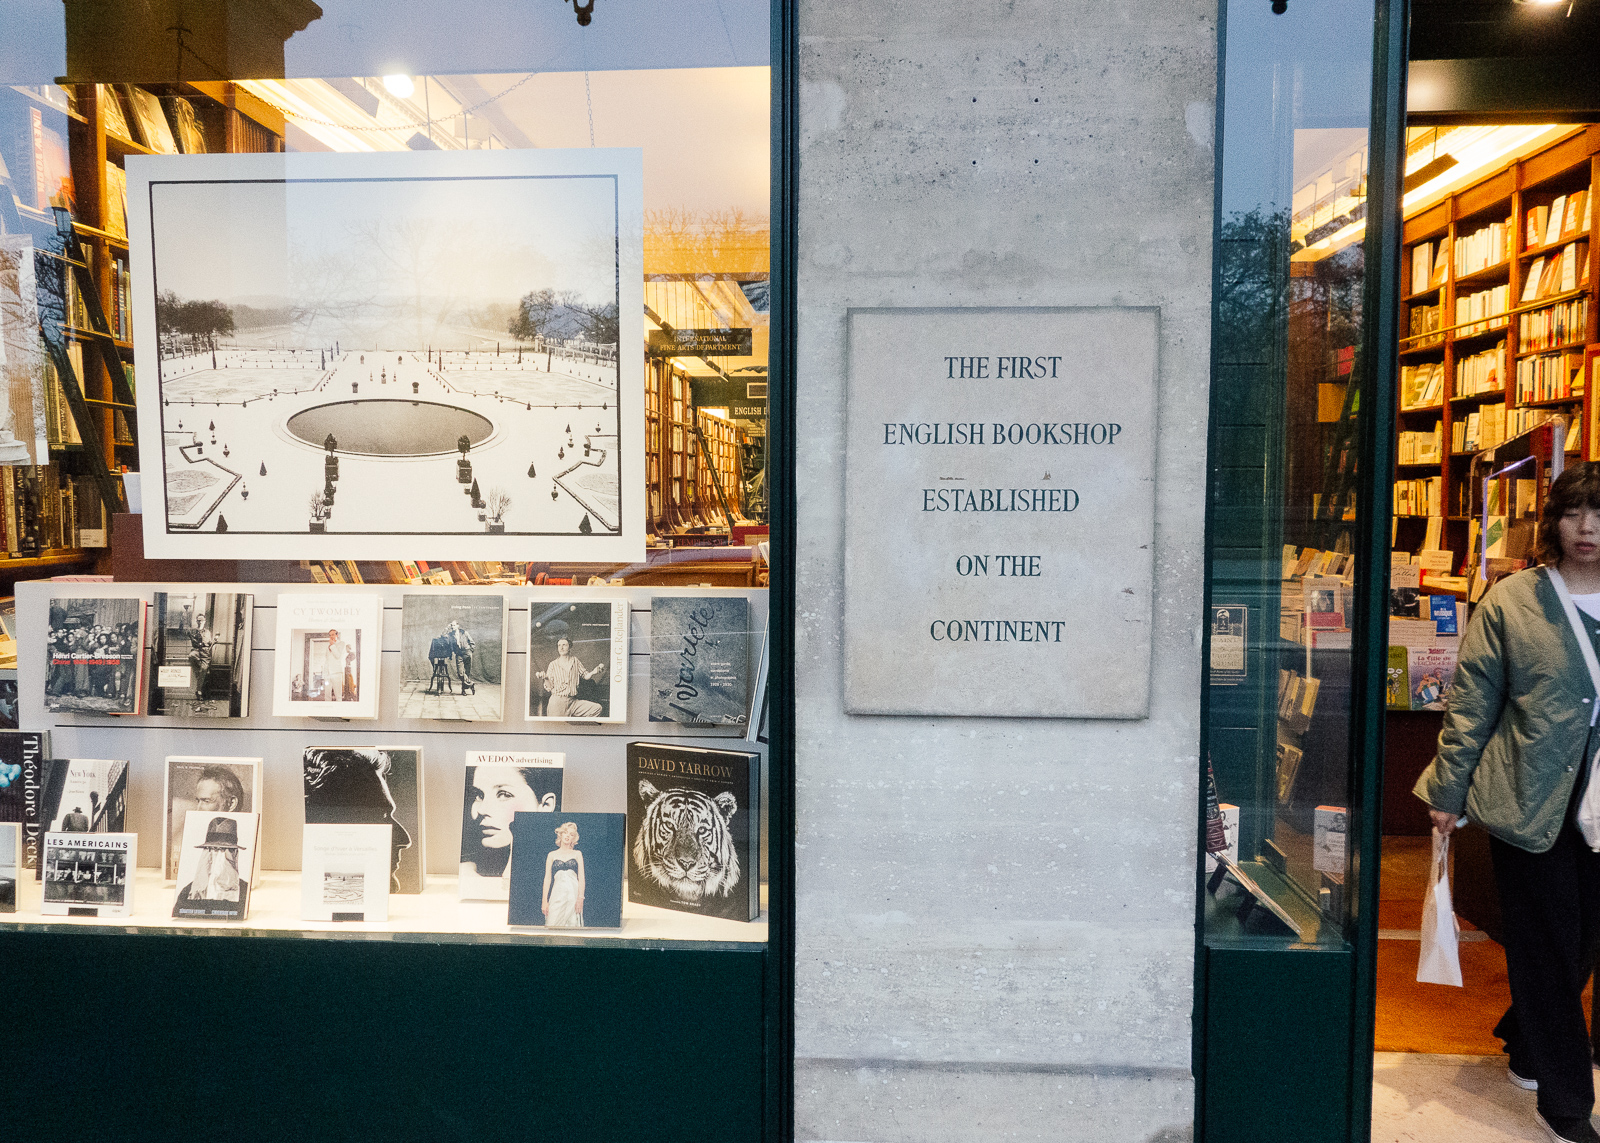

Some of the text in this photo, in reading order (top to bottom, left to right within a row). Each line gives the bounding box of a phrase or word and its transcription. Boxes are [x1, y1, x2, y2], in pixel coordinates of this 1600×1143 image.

[944, 355, 1062, 379] THE FIRST
[734, 406, 762, 416] ENGLISH
[883, 422, 1122, 446] ENGLISH BOOKSHOP
[921, 488, 1080, 513] ESTABLISHED
[955, 555, 1042, 578] ON THE
[293, 607, 361, 616] CY TWOMBLY
[614, 602, 625, 683] Oscar G. Rejlander
[930, 619, 1066, 643] CONTINENT
[476, 755, 553, 765] AVEDON advertising
[638, 756, 734, 778] DAVID YARROW
[23, 735, 40, 865] Théodore Deck
[47, 838, 128, 849] LES AMÉRICAINS
